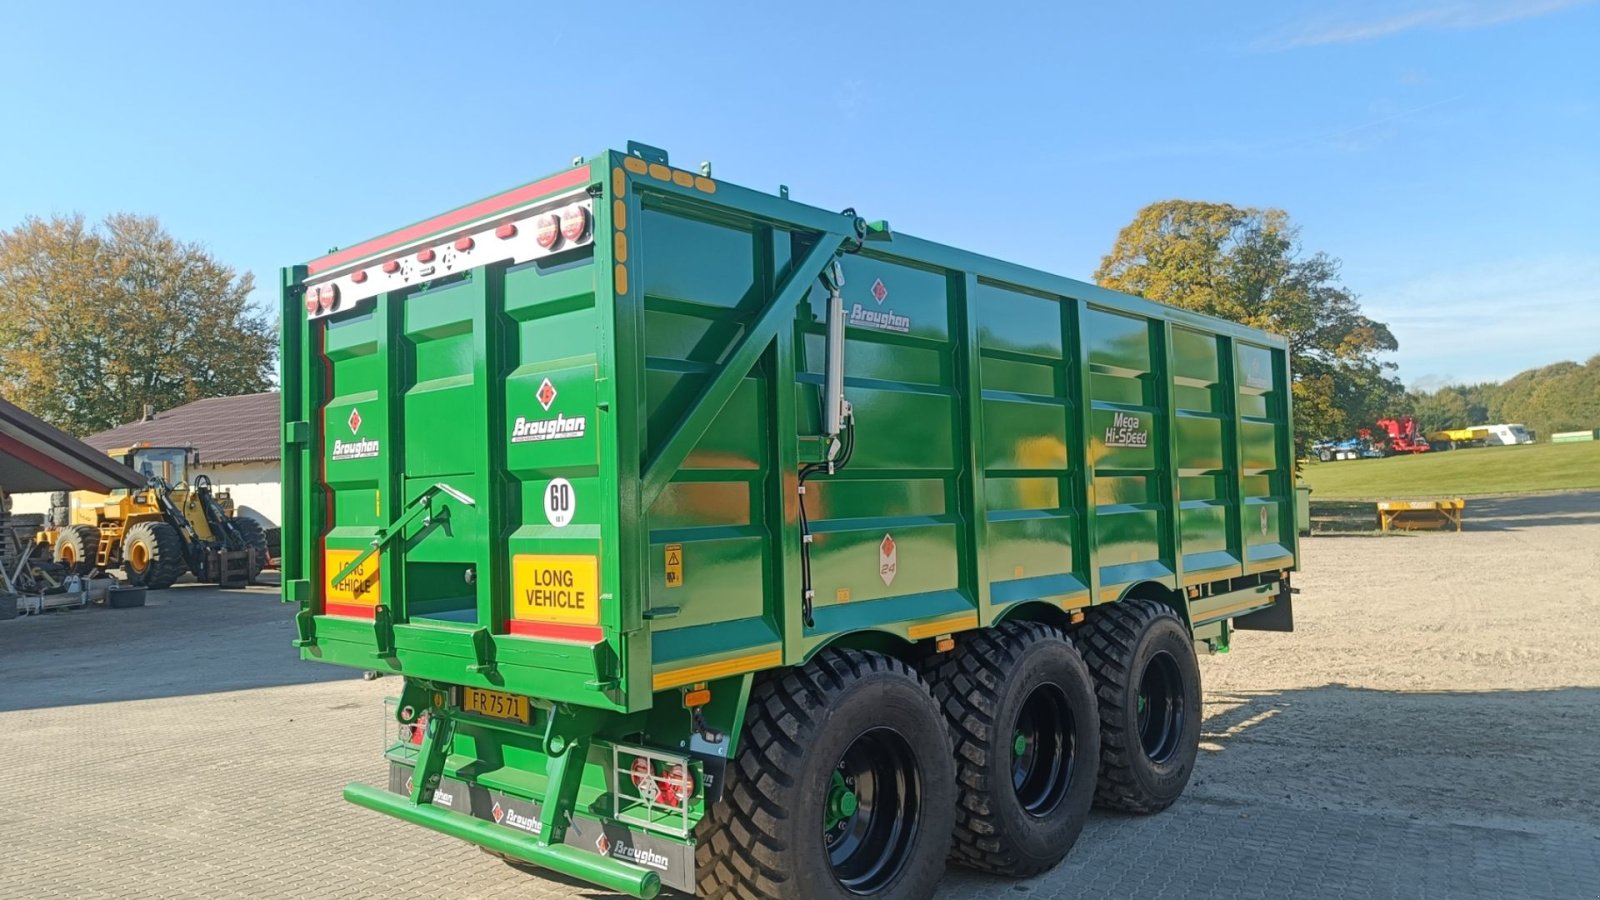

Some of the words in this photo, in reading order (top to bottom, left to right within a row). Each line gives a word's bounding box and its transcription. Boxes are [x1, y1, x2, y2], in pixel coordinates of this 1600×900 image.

[850, 303, 910, 329] Broughan
[511, 412, 586, 440] Broughan
[1113, 411, 1140, 431] Mega
[333, 437, 379, 457] Broughan
[1105, 427, 1148, 447] Hi-Speed
[550, 483, 569, 511] 60
[534, 569, 573, 588] LONG
[881, 562, 896, 575] 24
[526, 589, 585, 609] VEHICLE
[473, 691, 487, 711] FR
[490, 694, 503, 714] 75
[507, 697, 520, 717] 71
[614, 840, 669, 867] Broughan
